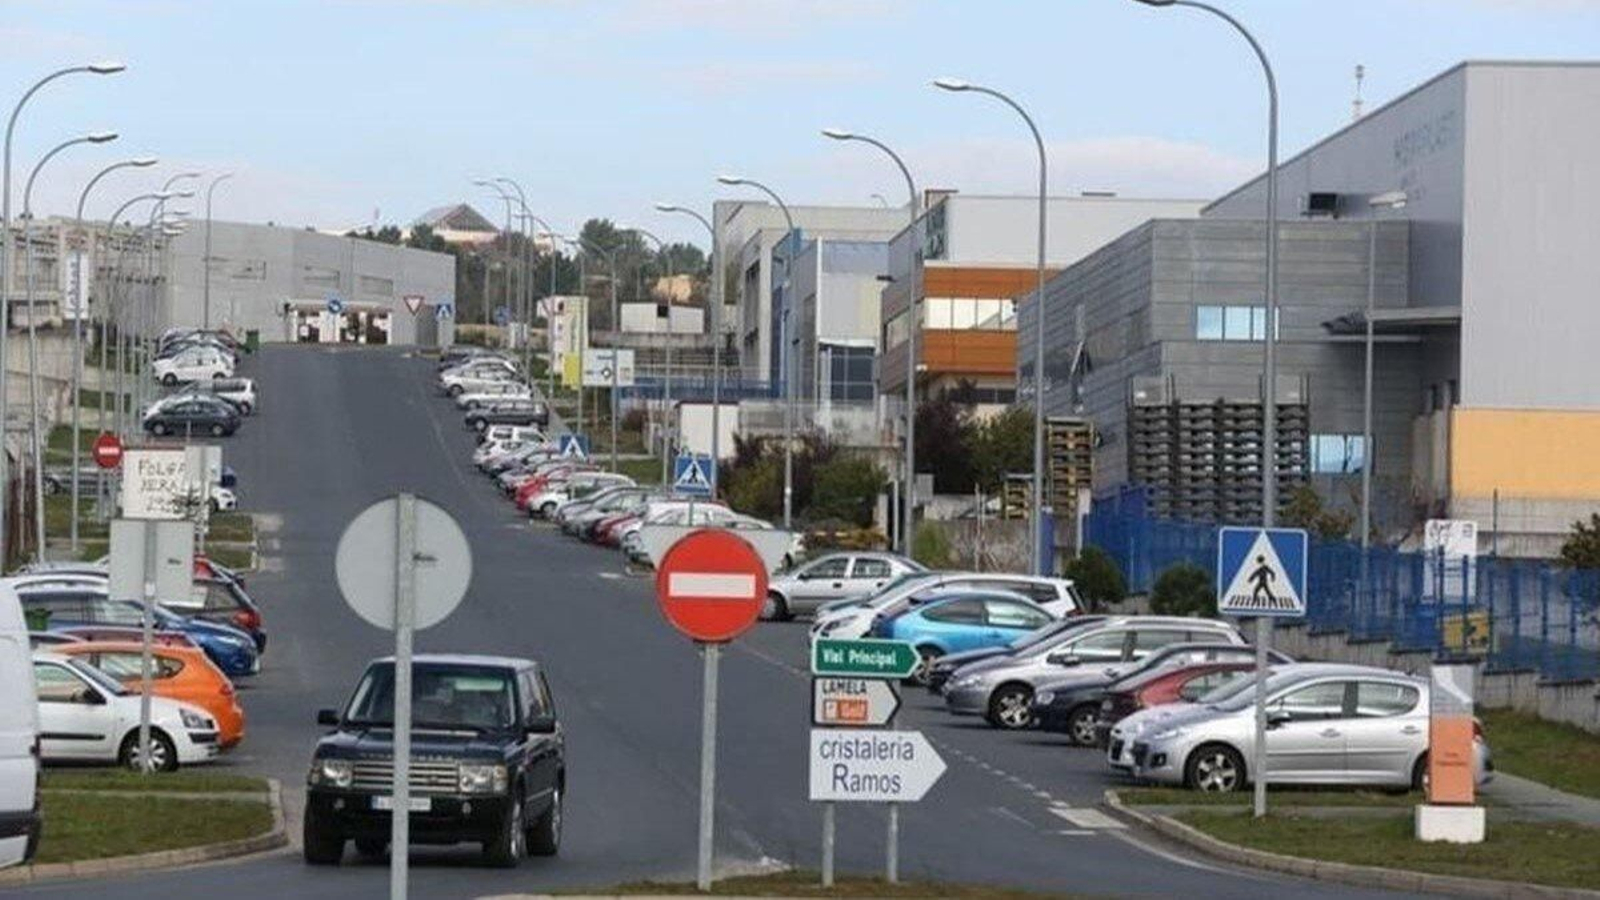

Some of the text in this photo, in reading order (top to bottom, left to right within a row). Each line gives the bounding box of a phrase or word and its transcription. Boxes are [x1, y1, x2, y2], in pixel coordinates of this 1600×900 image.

[822, 648, 898, 668] Vial Principal
[822, 680, 868, 695] LAMELA
[832, 762, 901, 793] Ramos
